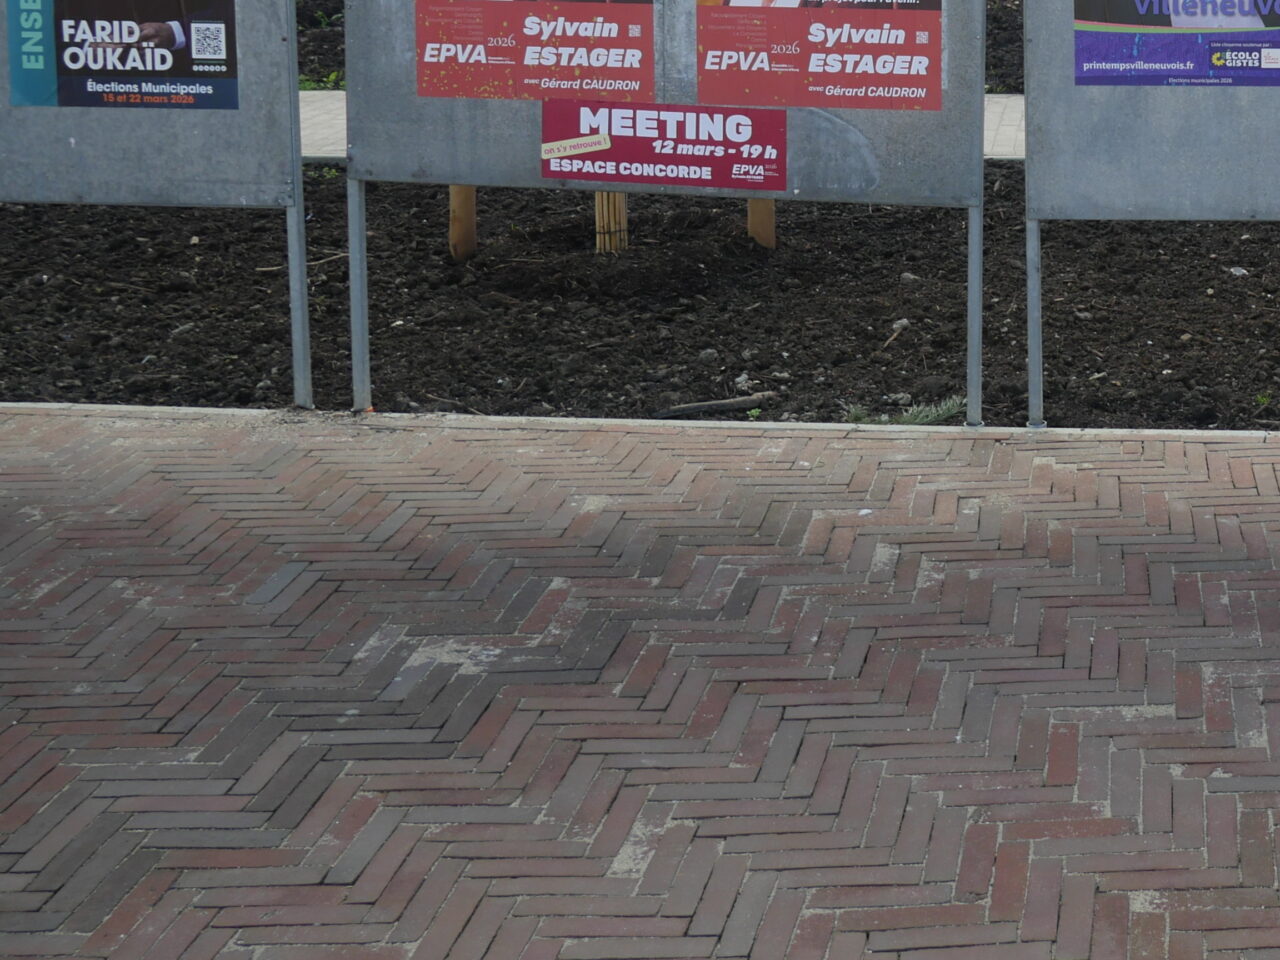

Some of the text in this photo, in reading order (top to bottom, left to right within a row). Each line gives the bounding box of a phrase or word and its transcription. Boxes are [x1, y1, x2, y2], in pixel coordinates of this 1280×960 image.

[61, 19, 141, 43] FARID
[523, 16, 619, 41] Sylvain
[807, 22, 906, 47] Sylvain
[487, 33, 517, 47] 2026
[770, 40, 800, 54] 2026
[63, 42, 174, 71] OUKAÏD
[423, 43, 487, 64] EPVA
[523, 46, 643, 68] ESTAGER
[704, 50, 770, 71] EPVA
[1226, 49, 1260, 60] ÉCOLO
[808, 53, 929, 76] ESTAGER
[1083, 60, 1195, 72] printempsvilleneuvois.fr
[86, 78, 214, 95] Élections Municipales
[540, 77, 580, 90] Gérard
[582, 79, 640, 91] CAUDRON
[825, 84, 865, 97] Gérard
[867, 86, 927, 98] CAUDRON
[103, 93, 195, 104] 15 et 22 mars 2026
[580, 107, 753, 143] MEETING
[569, 141, 602, 151] retrouve
[652, 140, 674, 154] 12
[677, 143, 725, 157] mars
[740, 144, 762, 159] 19
[764, 144, 778, 159] h
[550, 158, 712, 180] ESPACE CONCORDE
[732, 164, 765, 176] EPVA
